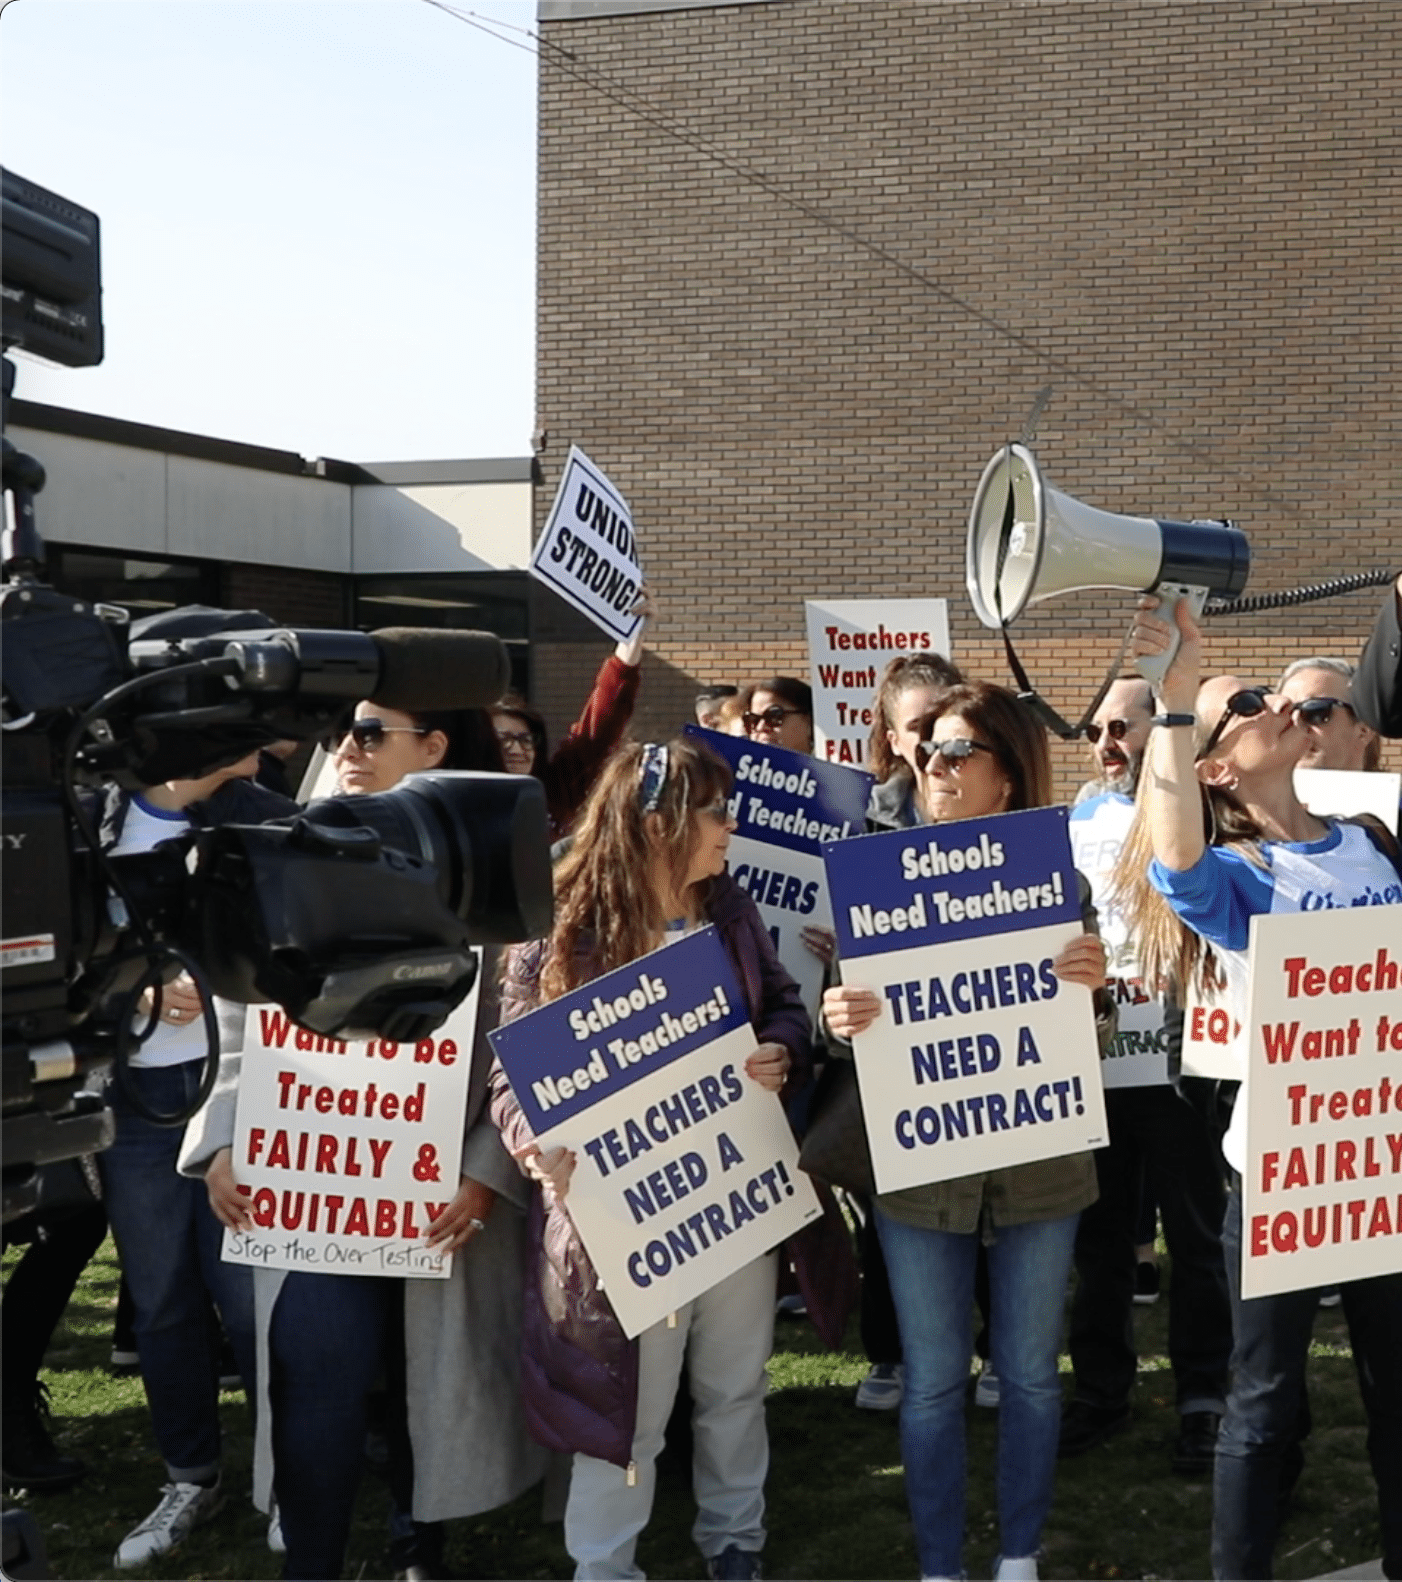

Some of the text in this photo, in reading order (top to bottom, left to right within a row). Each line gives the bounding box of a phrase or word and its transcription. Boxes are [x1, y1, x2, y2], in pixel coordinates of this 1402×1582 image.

[551, 526, 645, 617] STRONG!
[825, 624, 931, 650] Teachers
[818, 664, 876, 688] Want
[736, 754, 817, 798] Schools
[748, 797, 850, 842] Teachers!
[902, 834, 1005, 880] Schools
[849, 872, 1065, 938] Need Teachers!
[393, 962, 453, 979] Canon
[884, 957, 1059, 1026] TEACHERS
[570, 973, 668, 1041] Schools
[532, 985, 732, 1113] Need Teachers!
[911, 1025, 1041, 1086] NEED A
[1261, 1018, 1361, 1064] Want
[278, 1071, 426, 1122] Treated
[584, 1063, 744, 1178] TEACHERS
[894, 1076, 1086, 1150] CONTRACT!
[248, 1127, 441, 1183] FAIRLY &
[623, 1131, 744, 1226] NEED A
[228, 1234, 277, 1263] Stop
[284, 1239, 318, 1264] the
[323, 1242, 370, 1264] Over
[626, 1160, 796, 1289] CONTRACT!
